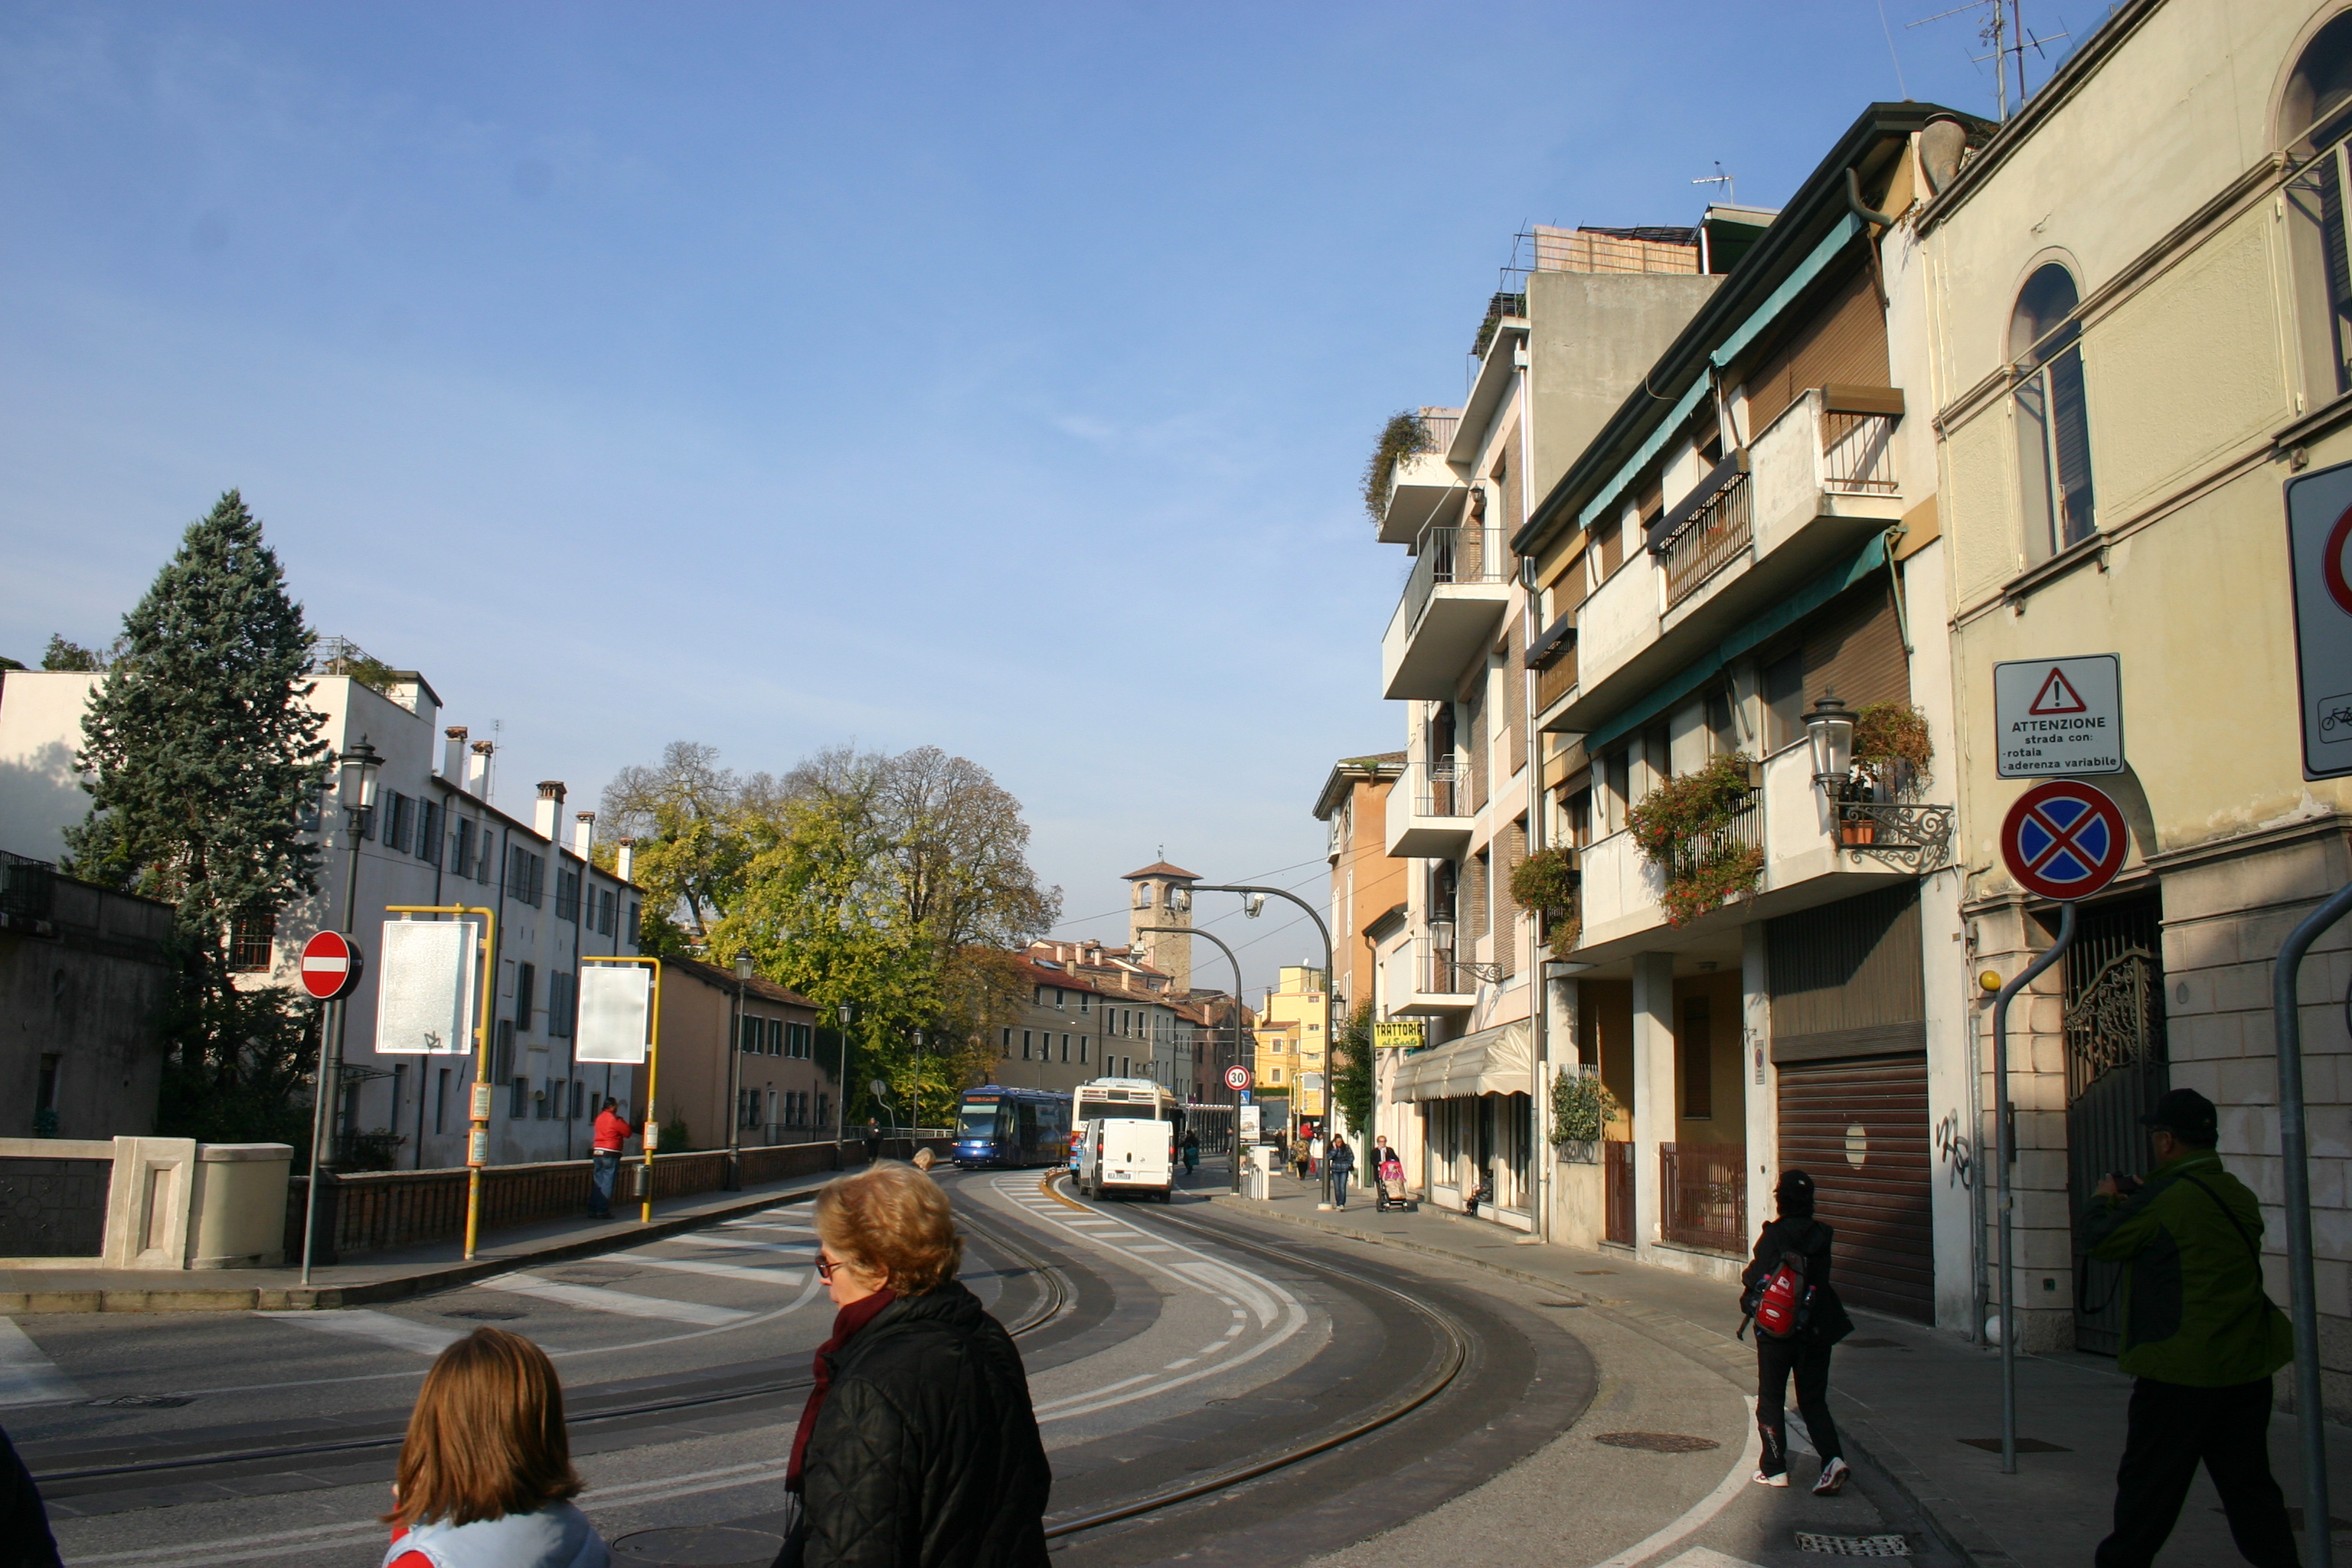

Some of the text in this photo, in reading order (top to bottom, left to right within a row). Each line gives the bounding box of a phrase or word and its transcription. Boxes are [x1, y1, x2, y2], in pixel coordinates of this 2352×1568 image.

[2011, 717, 2106, 733] ATTENZIONE
[2024, 733, 2063, 744] strada
[2064, 756, 2117, 767] variabile
[1376, 1023, 1423, 1037] TRATTORIA
[1230, 1072, 1244, 1083] 30
